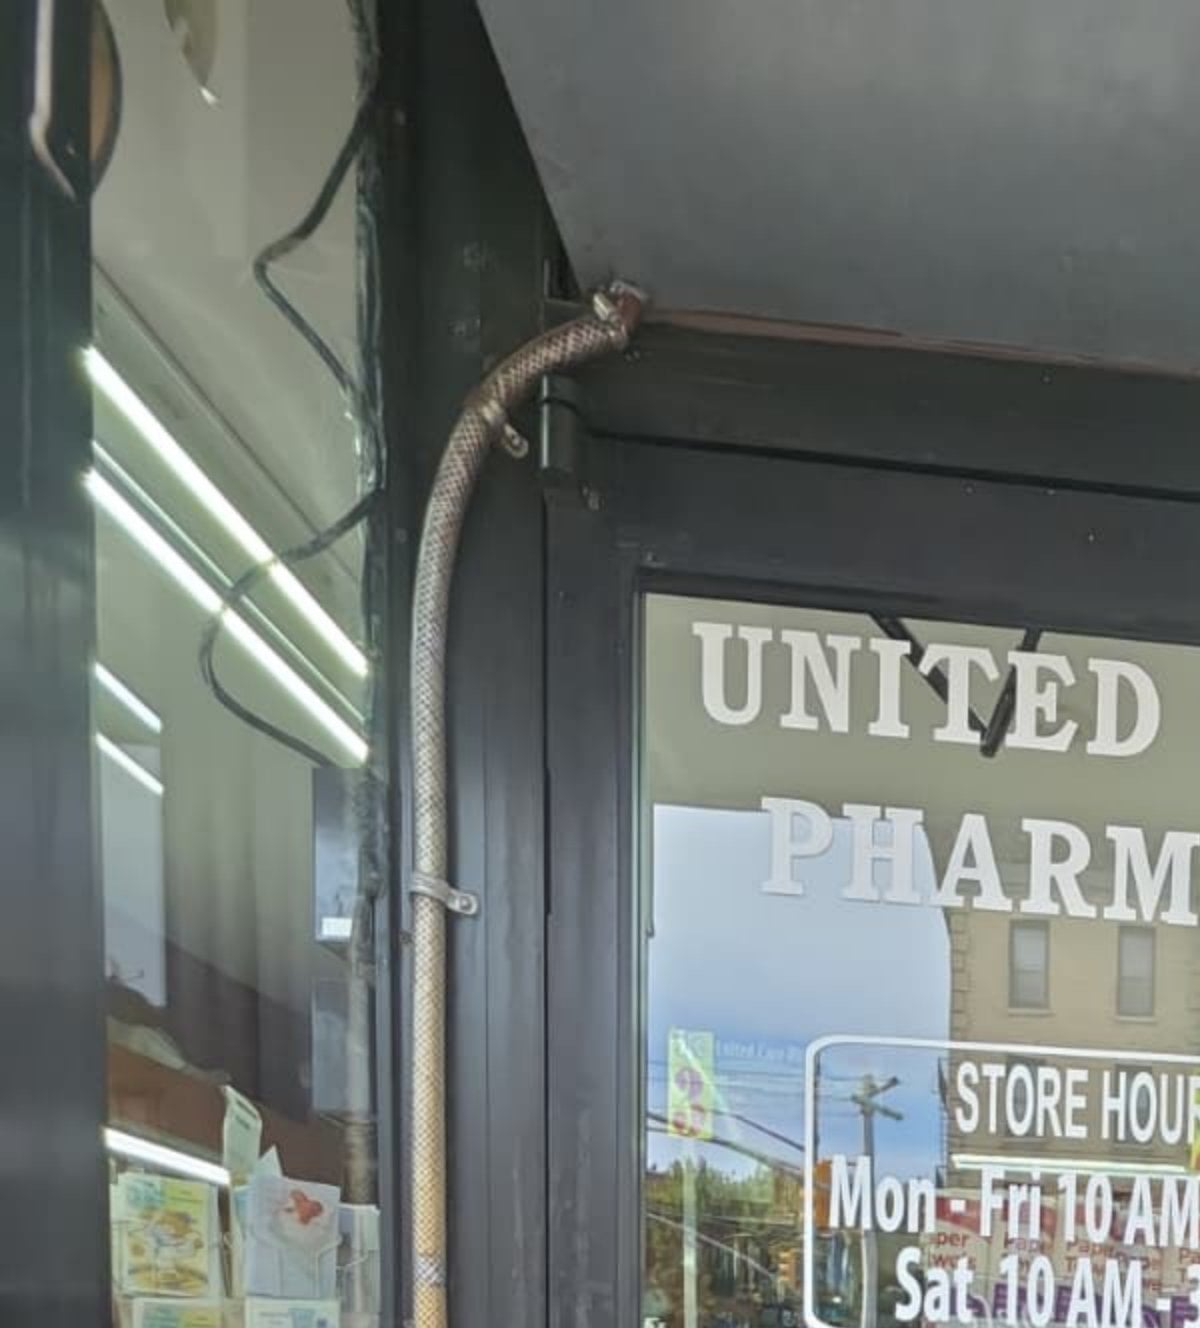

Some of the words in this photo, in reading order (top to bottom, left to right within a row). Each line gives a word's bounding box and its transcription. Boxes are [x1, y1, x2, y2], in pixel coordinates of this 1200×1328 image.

[692, 621, 1162, 758] UNITED
[955, 1061, 1090, 1141] STORE
[828, 1153, 937, 1235] Mon
[979, 1166, 1042, 1241] Fri
[1056, 1173, 1115, 1246] 10
[894, 1247, 974, 1323] Sat
[999, 1255, 1055, 1328] 10
